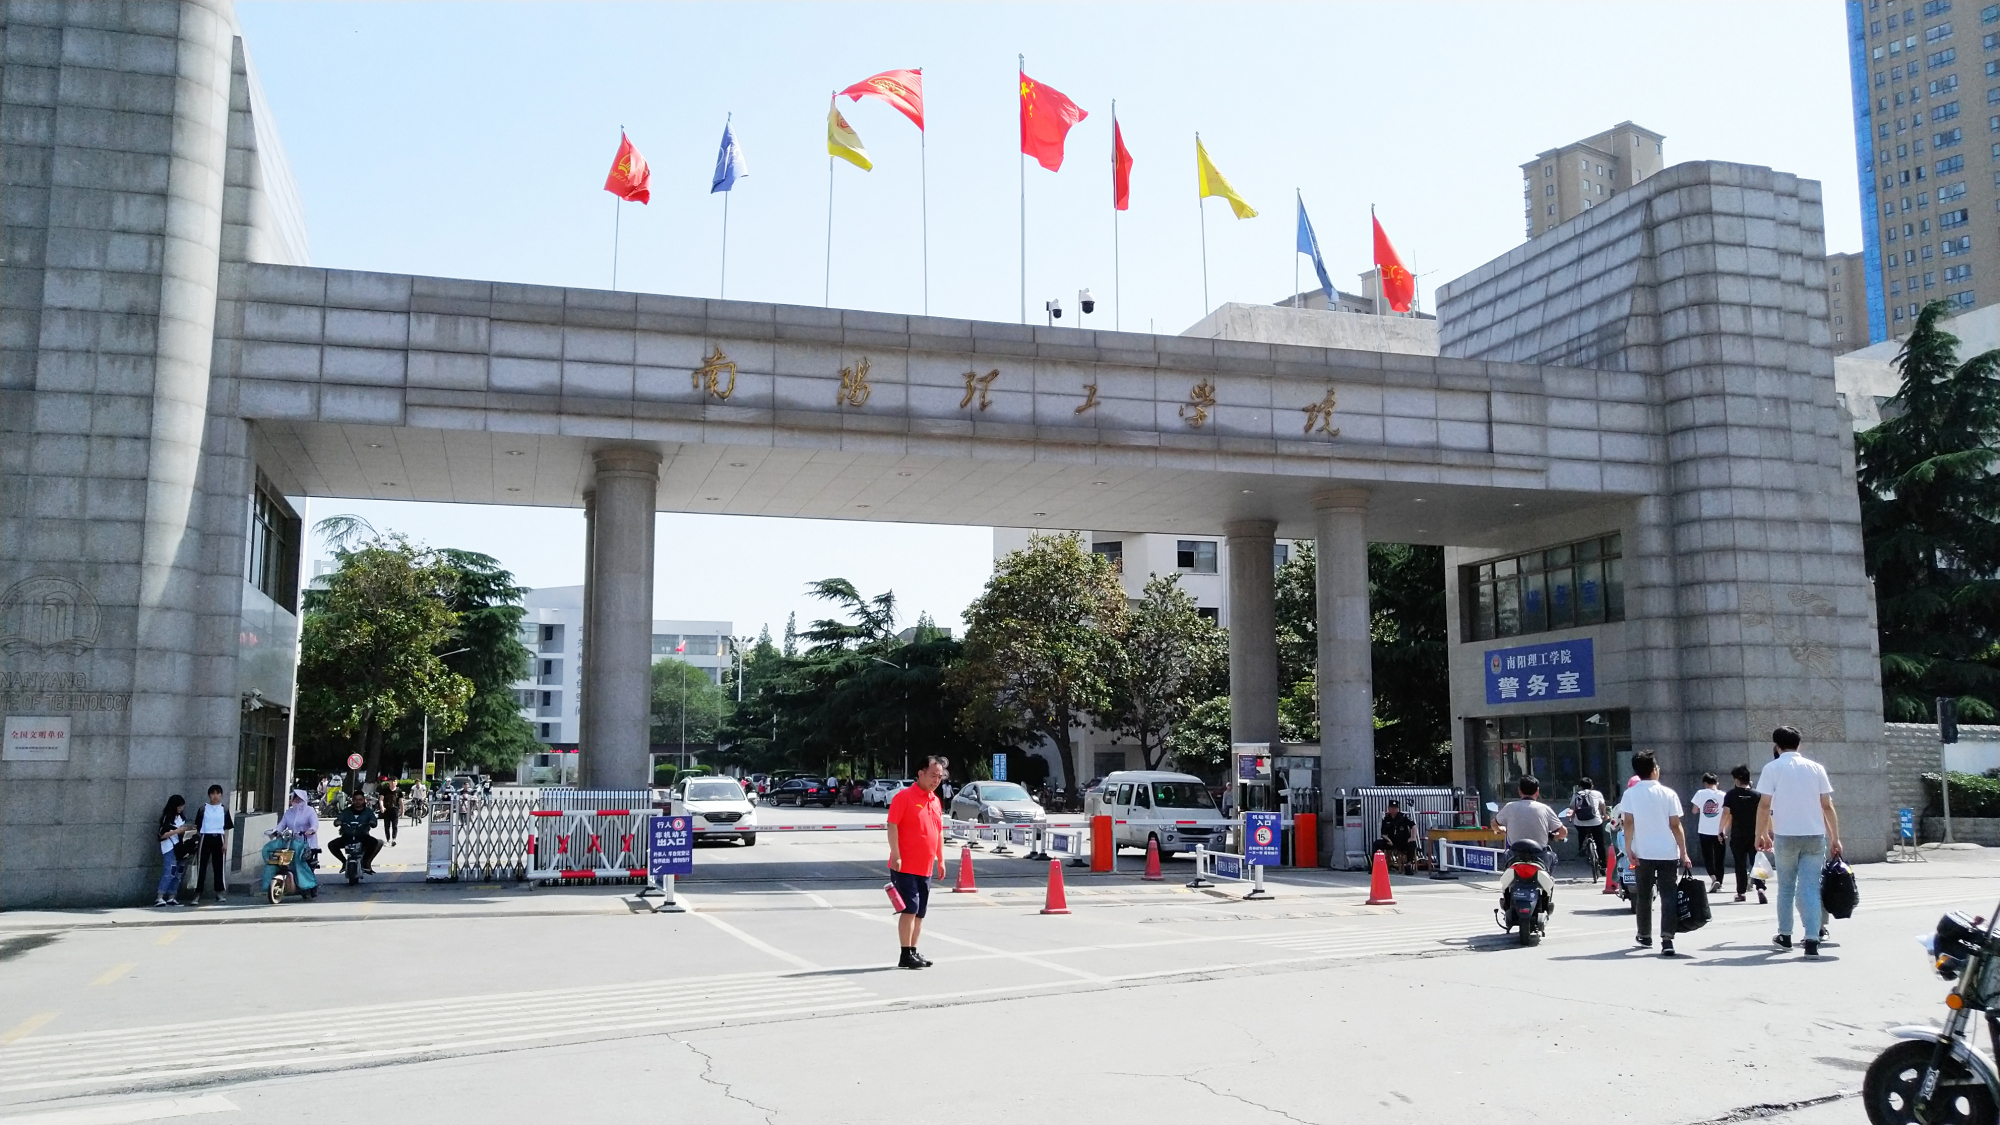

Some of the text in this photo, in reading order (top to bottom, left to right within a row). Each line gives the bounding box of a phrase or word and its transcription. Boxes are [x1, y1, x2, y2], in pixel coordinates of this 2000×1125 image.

[1506, 649, 1571, 670] 南阳理工学院
[1498, 671, 1580, 698] 警务室
[46, 693, 131, 712] TECHNOLOGY
[11, 730, 65, 739] 全国文明单位
[656, 821, 671, 829] 行人
[655, 830, 687, 838] 非机动车
[657, 838, 686, 846] 出入口
